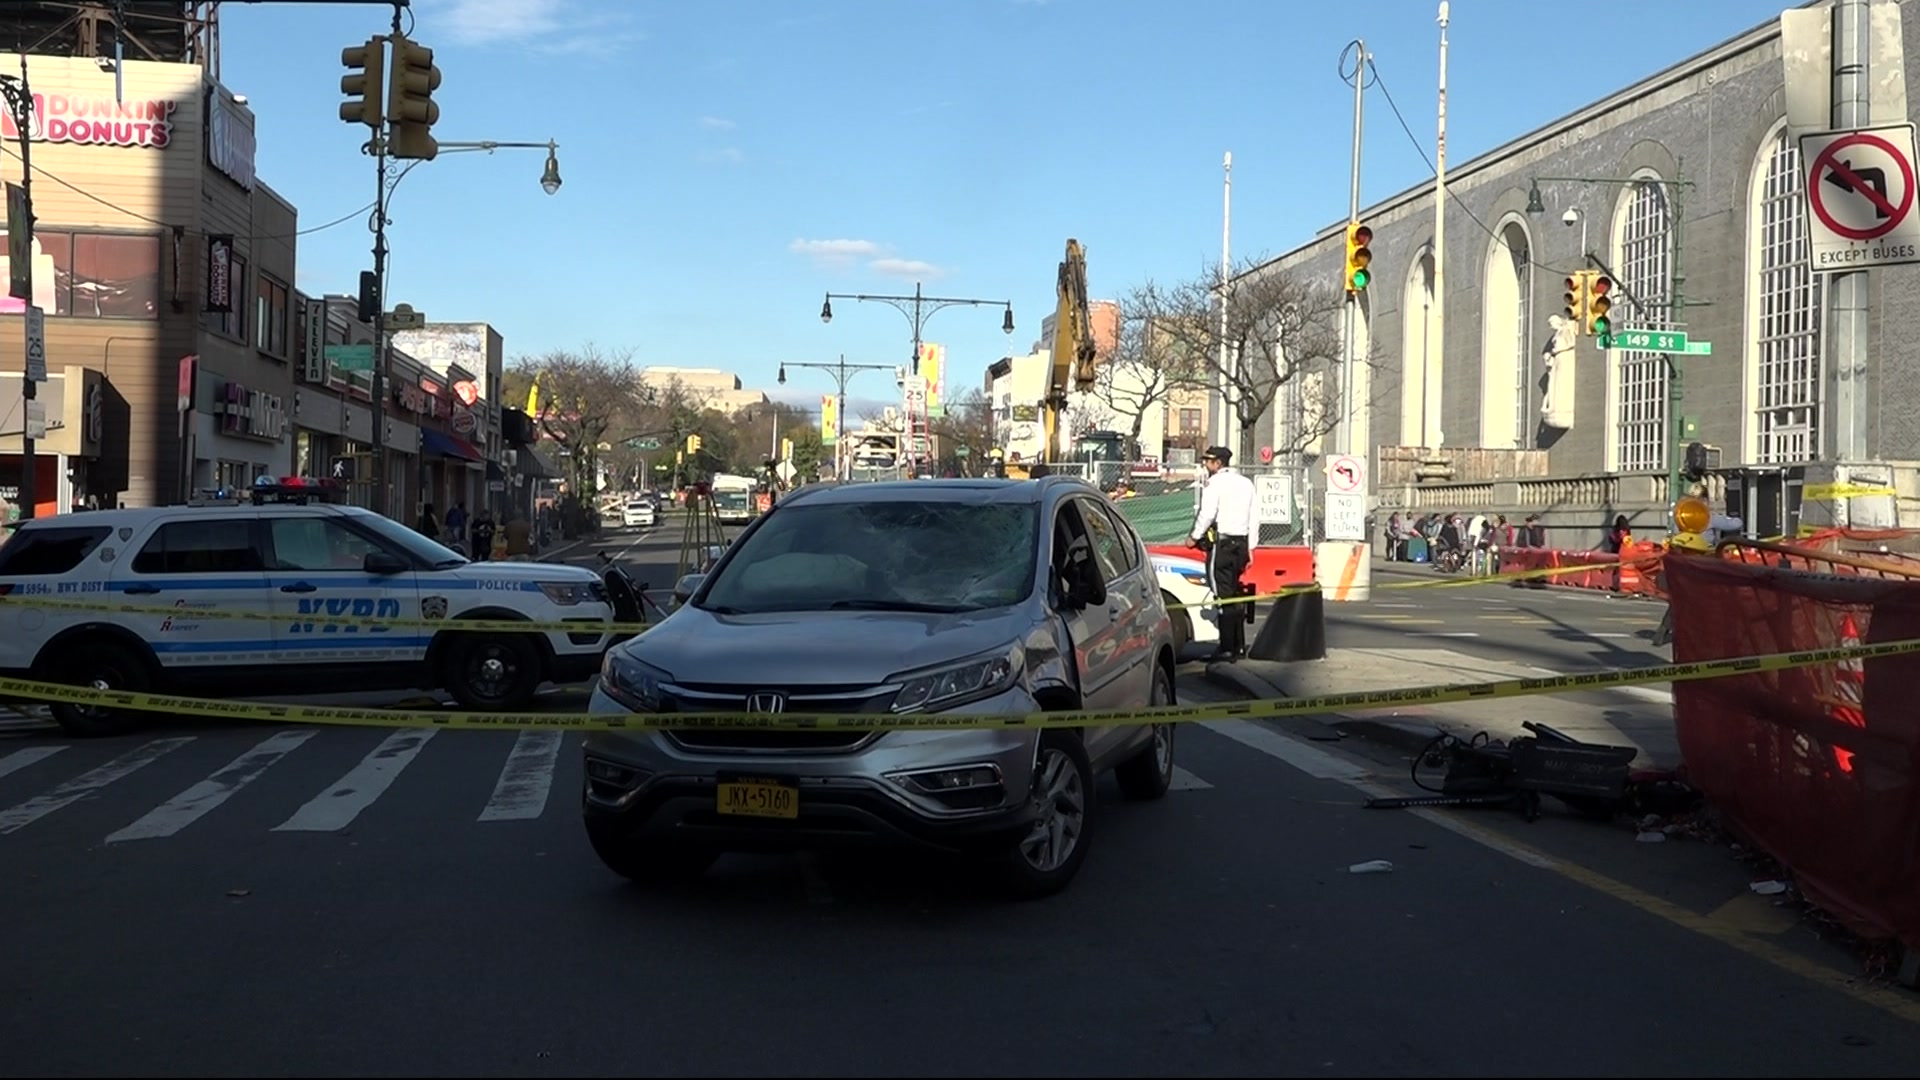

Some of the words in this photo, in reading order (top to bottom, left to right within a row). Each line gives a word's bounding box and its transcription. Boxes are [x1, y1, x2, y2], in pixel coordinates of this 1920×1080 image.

[50, 94, 175, 121] DUNKIN'
[49, 119, 167, 146] DONUTS
[1819, 249, 1868, 264] EXCEPT
[1873, 245, 1915, 260] BUSES
[1626, 335, 1649, 346] 149
[1658, 335, 1674, 348] St
[906, 389, 923, 400] 25
[1266, 481, 1280, 490] NO
[1262, 494, 1285, 503] LEFT
[1338, 499, 1353, 508] NO
[1260, 508, 1286, 517] TURN
[1334, 511, 1357, 520] LEFT
[1332, 523, 1359, 533] TURN
[25, 583, 47, 594] 5954
[57, 582, 78, 593] HWY
[81, 581, 102, 592] DIST
[478, 580, 520, 591] POLICE
[290, 598, 400, 633] NYPD
[1788, 653, 1813, 663] CROSS
[1830, 651, 1841, 659] DO
[1519, 679, 1542, 689] CROSS
[1558, 676, 1568, 686] DO
